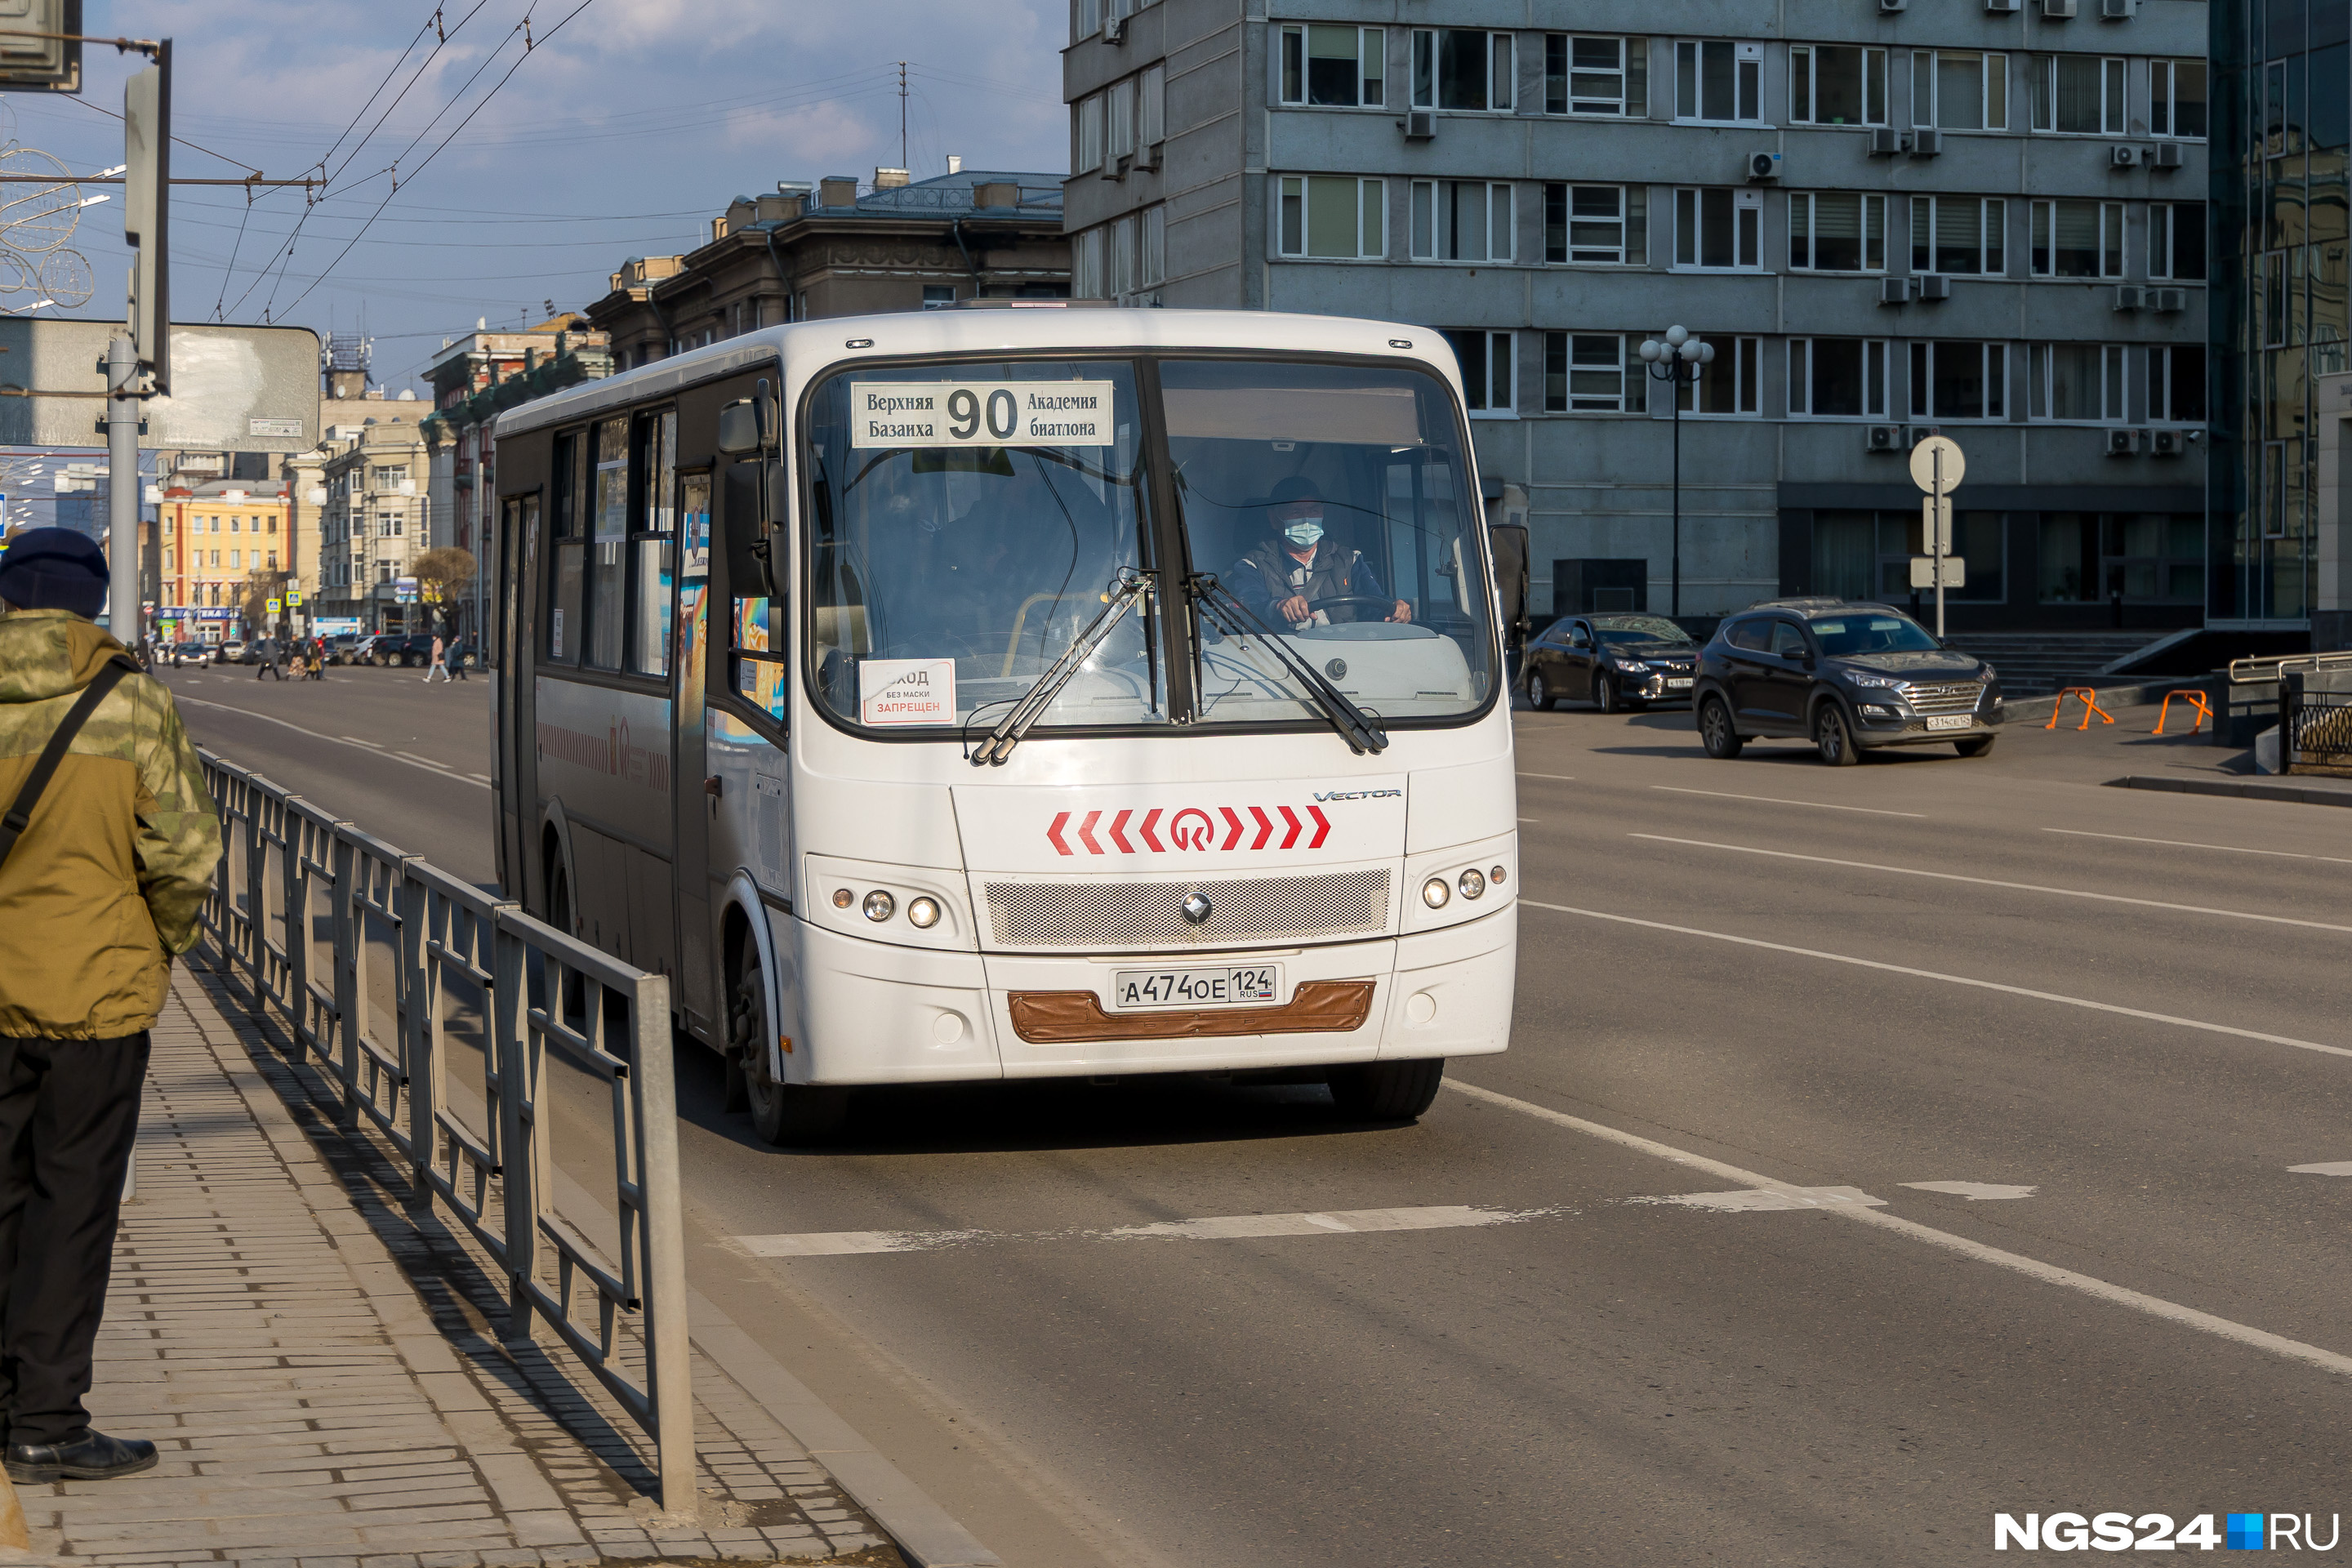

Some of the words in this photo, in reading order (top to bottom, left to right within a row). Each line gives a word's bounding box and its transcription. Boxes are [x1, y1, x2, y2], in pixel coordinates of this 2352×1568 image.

[866, 394, 934, 415] Верхняя
[1027, 393, 1098, 412] Академия
[947, 389, 1018, 439] 90
[868, 421, 934, 437] Базаиха
[1030, 416, 1096, 437] биатлона
[889, 670, 929, 686] ХОД
[877, 702, 940, 713] ЗАПРЕЩЕН
[1125, 974, 1226, 1002] А474ОЕ
[1232, 969, 1268, 991] 124
[1240, 990, 1258, 998] RUS
